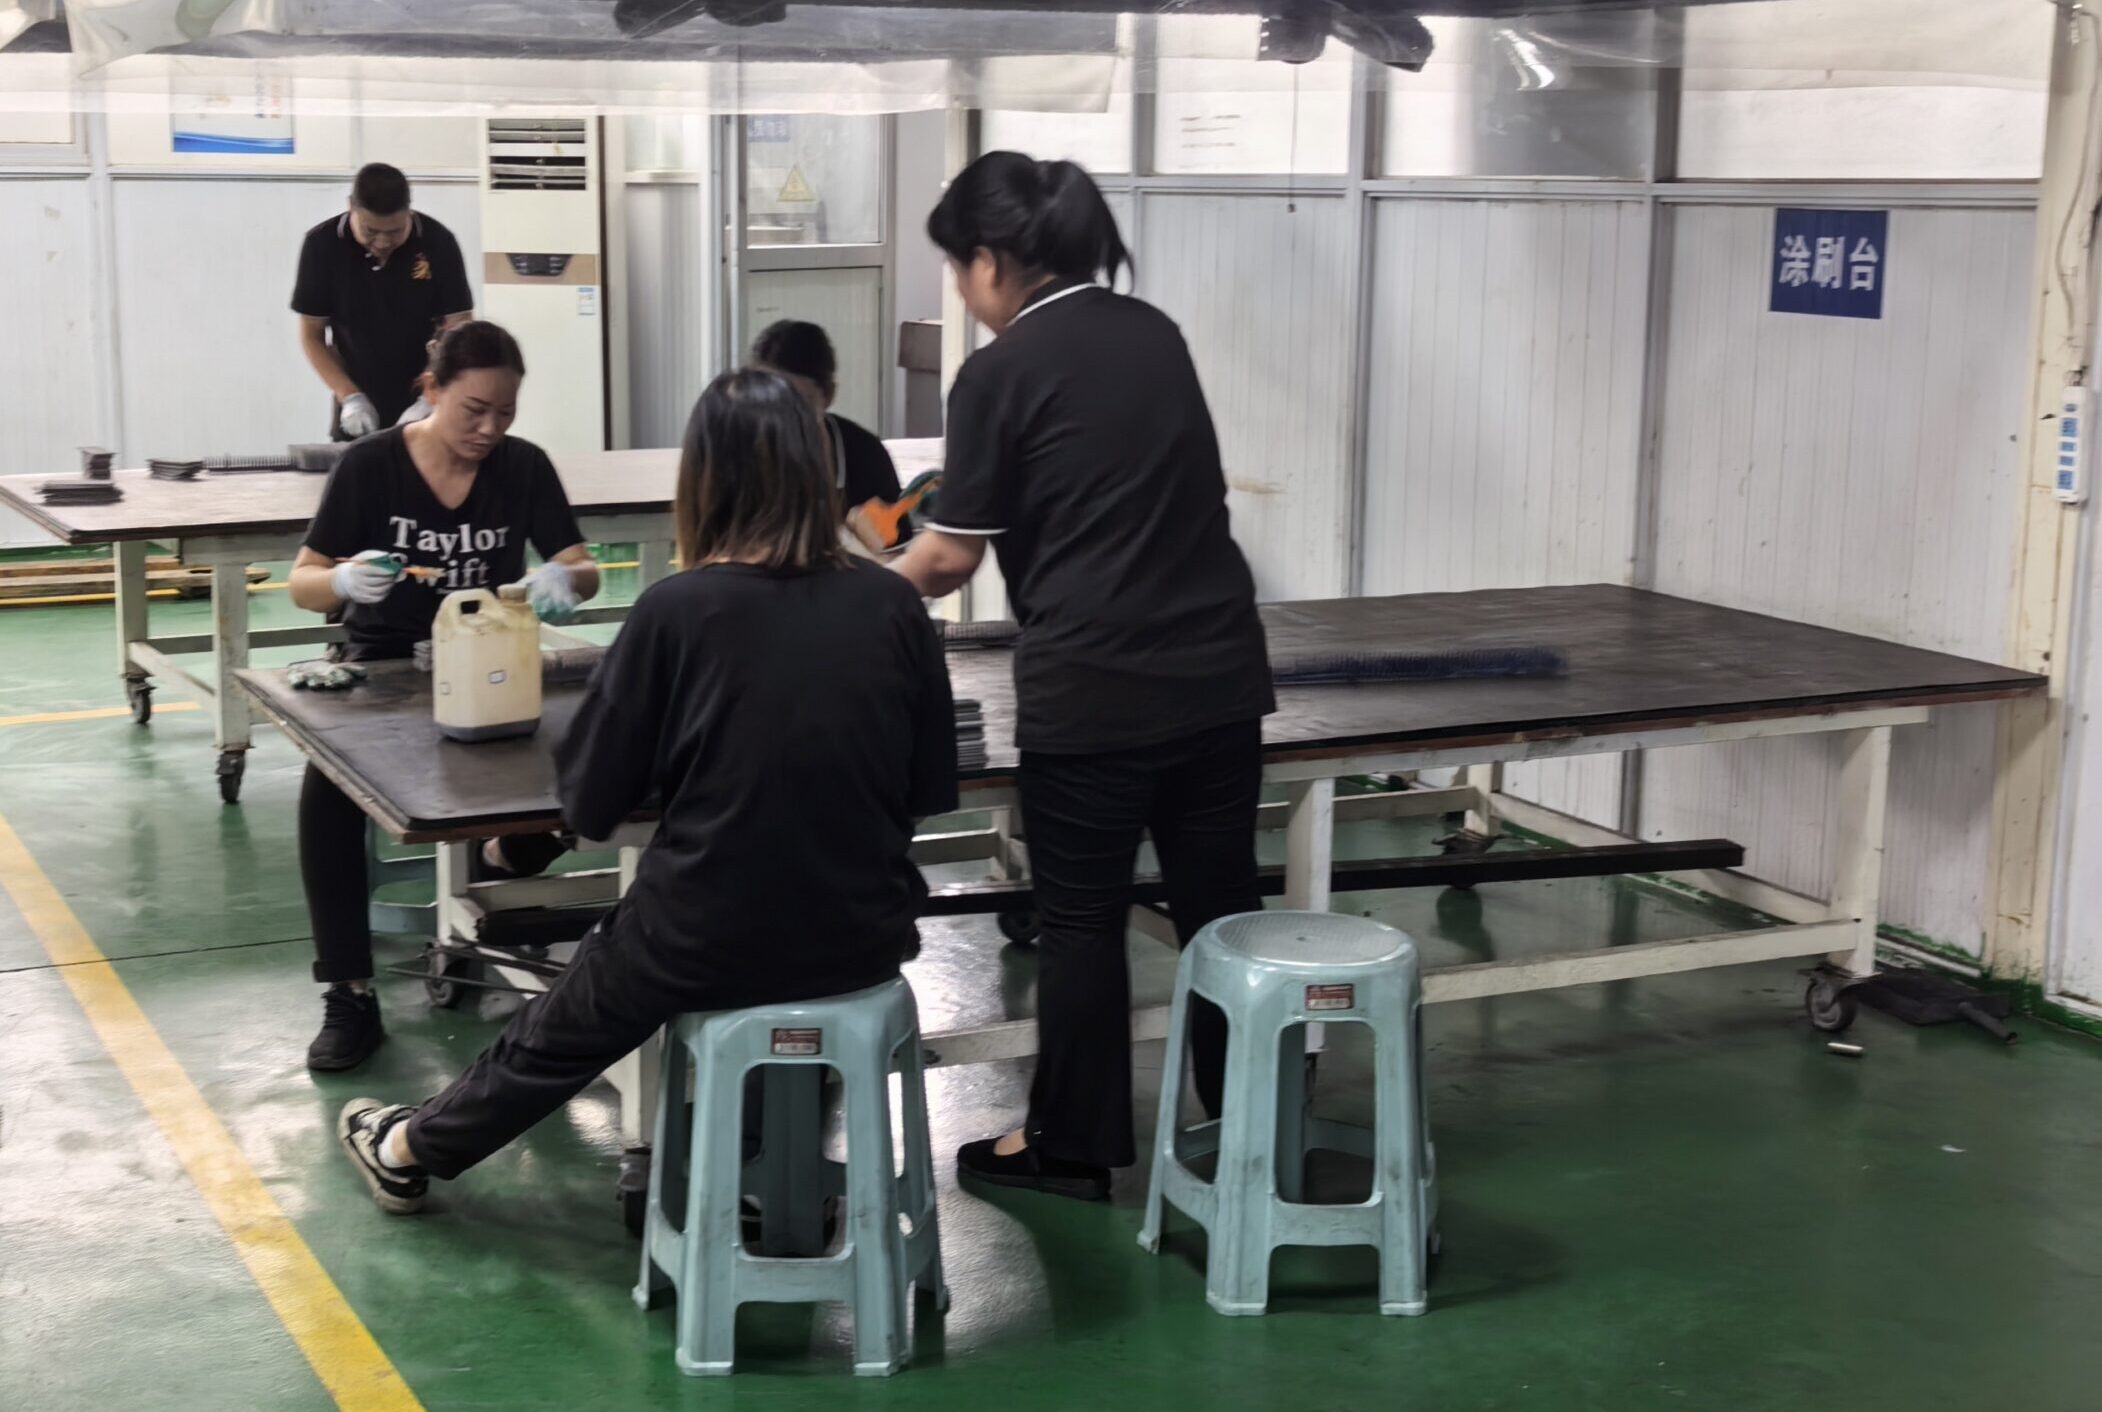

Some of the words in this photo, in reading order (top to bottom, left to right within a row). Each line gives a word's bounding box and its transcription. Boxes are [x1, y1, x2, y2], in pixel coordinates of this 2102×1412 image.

[1779, 234, 1879, 291] 涂刷台
[389, 515, 510, 561] Taylor
